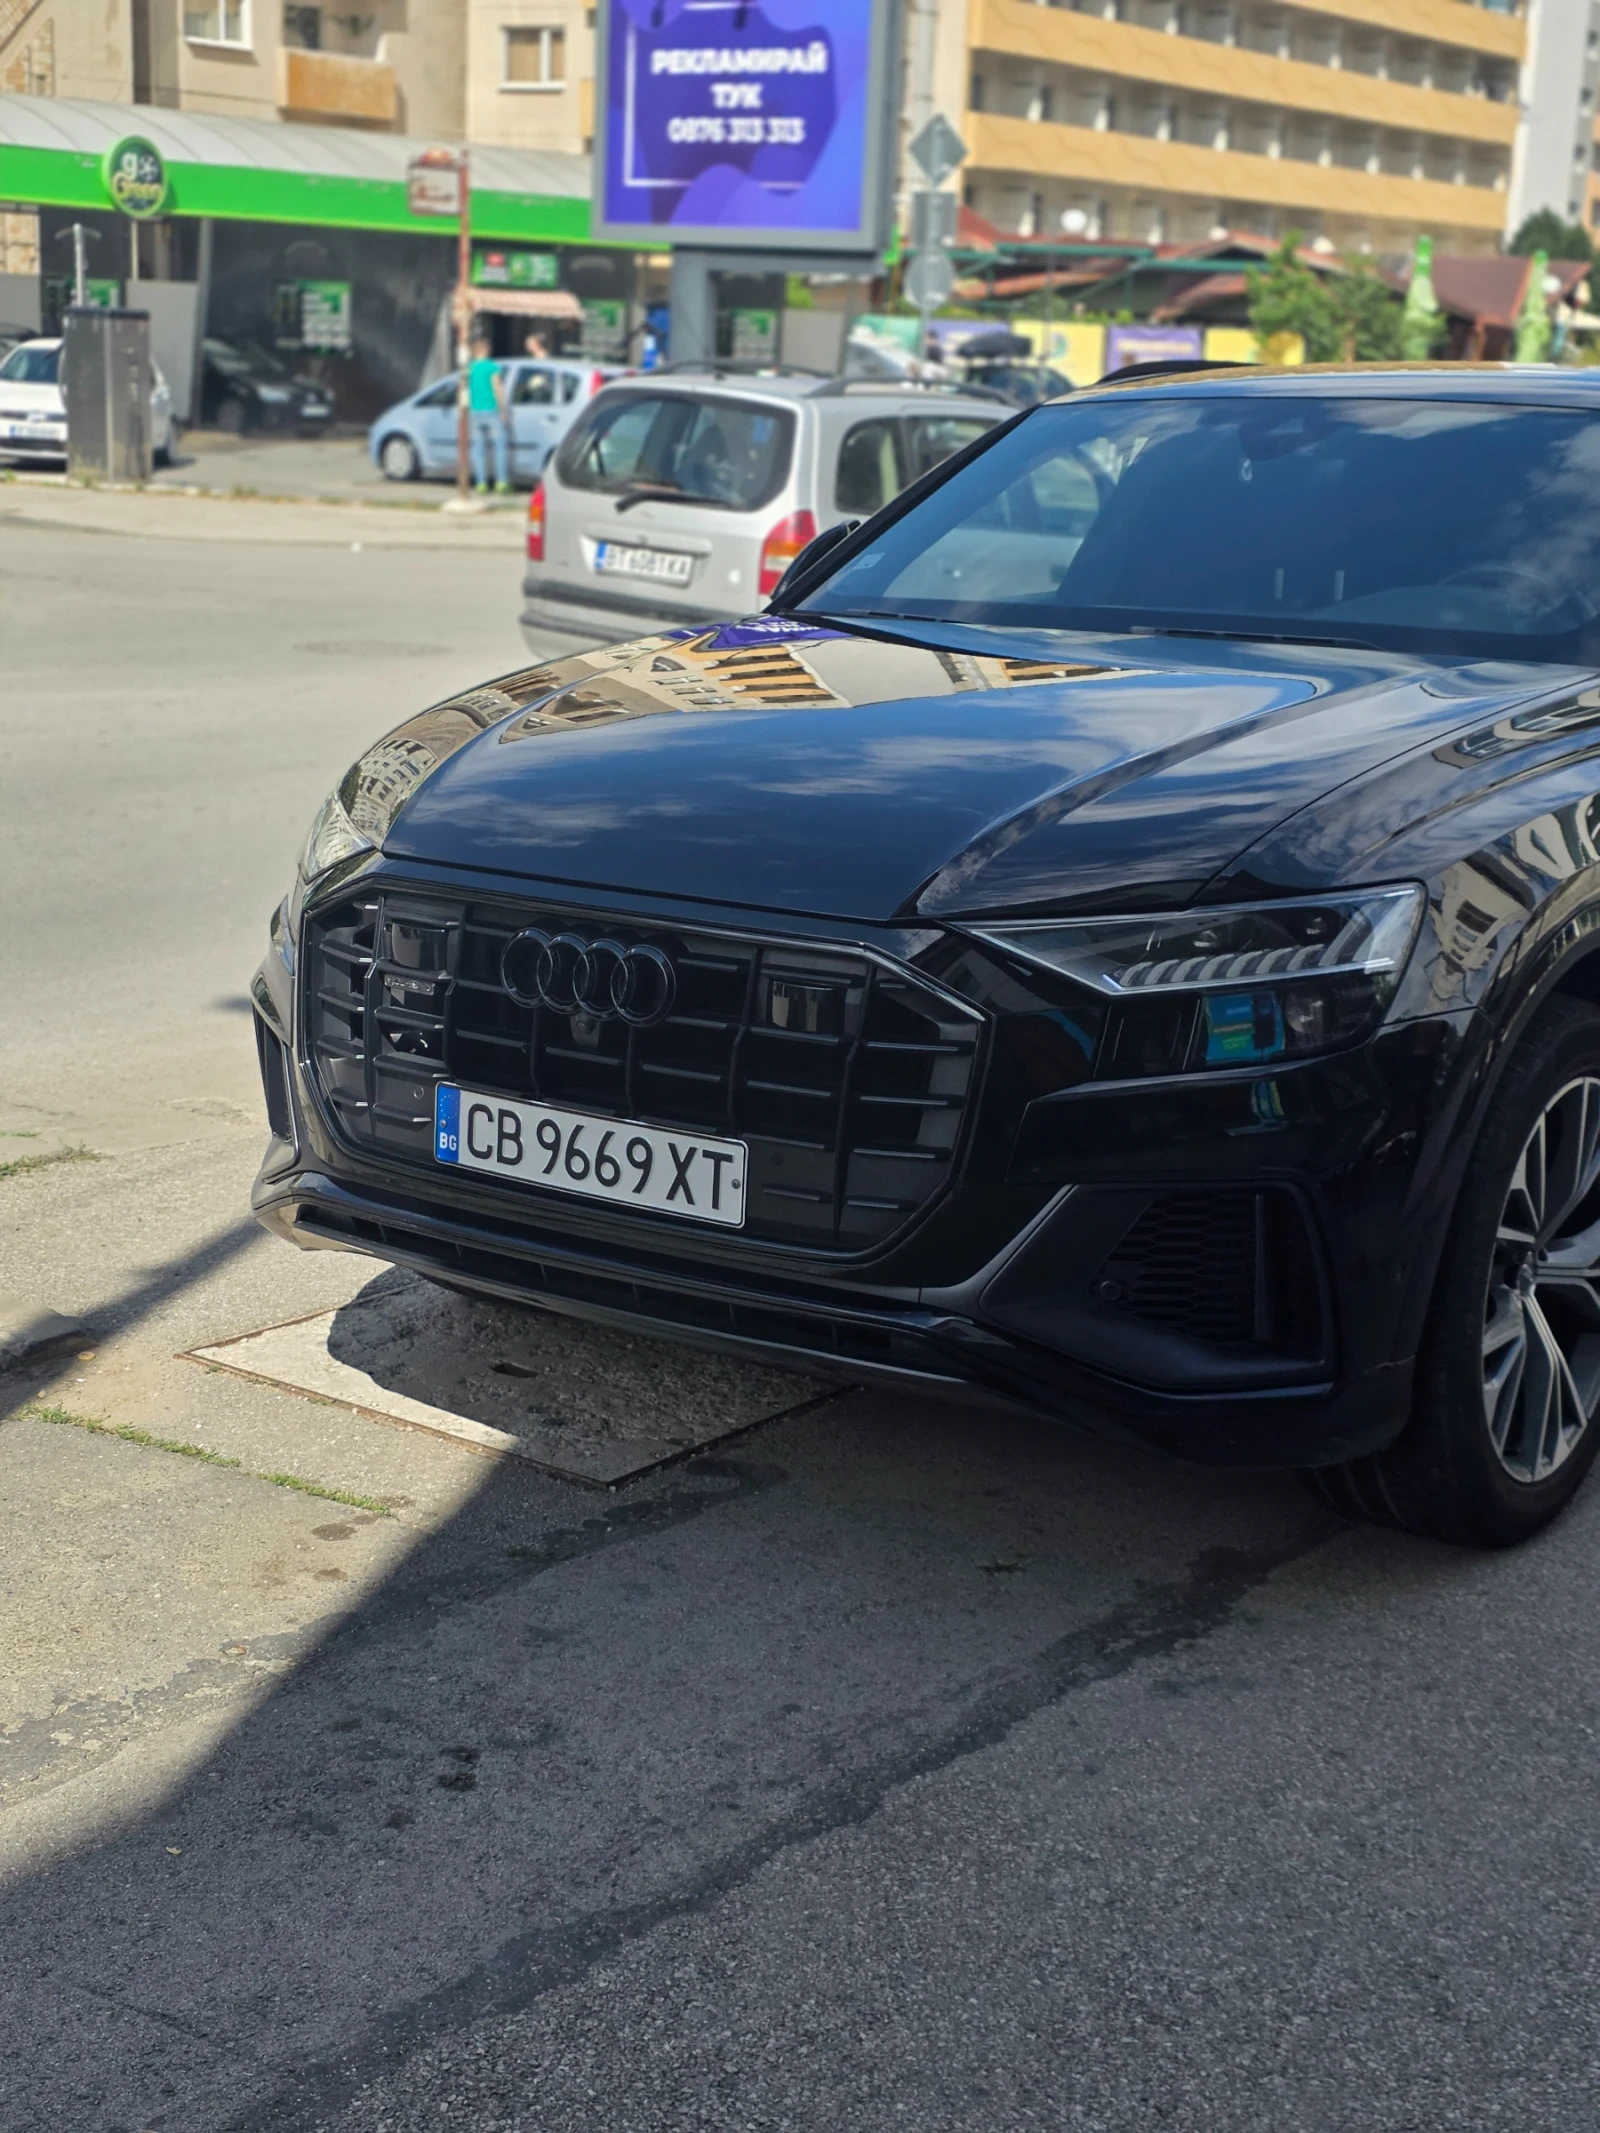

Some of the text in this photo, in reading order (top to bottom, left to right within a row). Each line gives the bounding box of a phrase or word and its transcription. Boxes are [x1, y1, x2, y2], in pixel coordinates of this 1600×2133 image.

[652, 41, 827, 74] РЕКЛАМИРАЙ
[710, 83, 763, 108] ТУК
[667, 117, 725, 143] 0876
[440, 1132, 457, 1151] BG
[467, 1103, 734, 1210] CB 9669 XT
